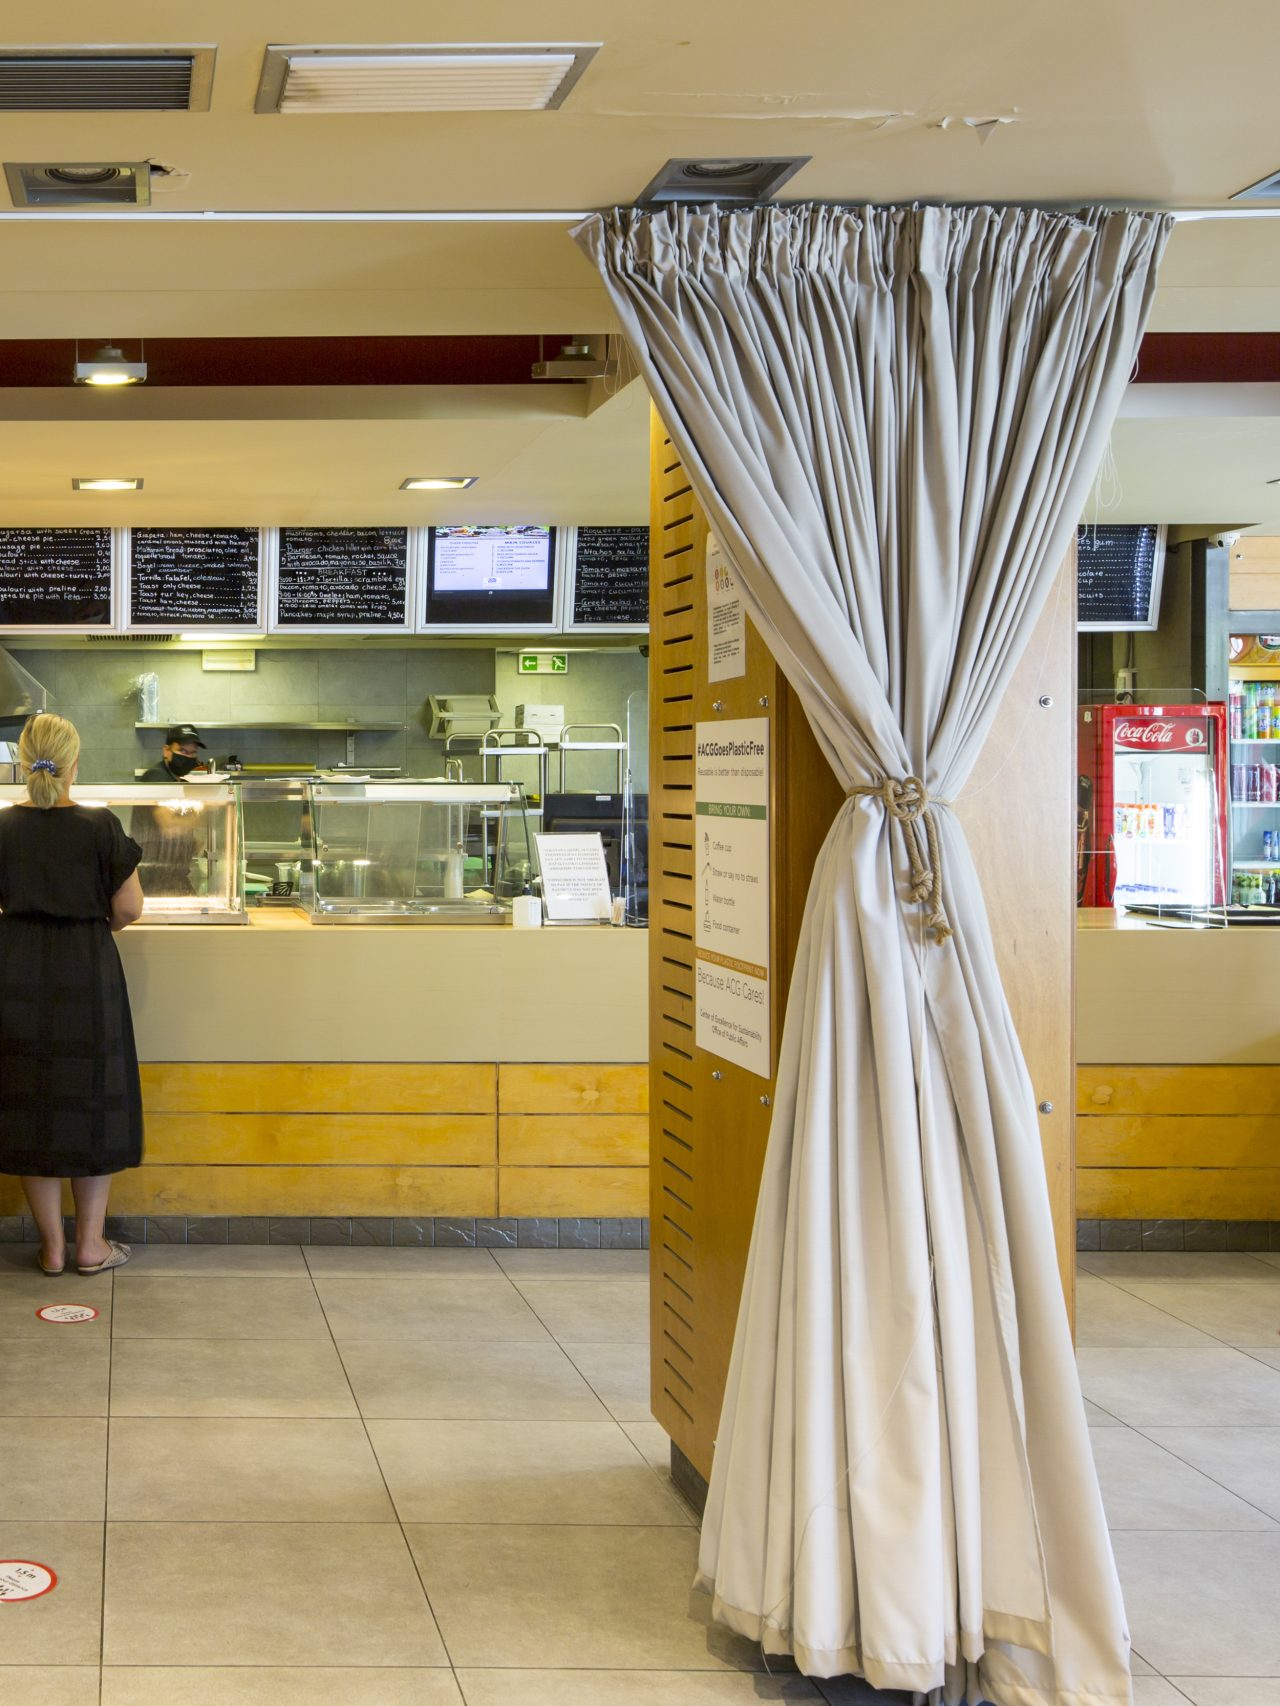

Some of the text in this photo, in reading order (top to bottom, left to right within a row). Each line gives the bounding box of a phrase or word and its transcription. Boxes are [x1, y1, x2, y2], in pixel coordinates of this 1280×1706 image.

[1114, 722, 1176, 743] Coca-Cola
[697, 740, 765, 757] #ACGGoesPlasticFree
[708, 803, 722, 815] BRING
[723, 804, 736, 816] YOUR
[697, 967, 724, 991] Because
[725, 976, 741, 996] ACG
